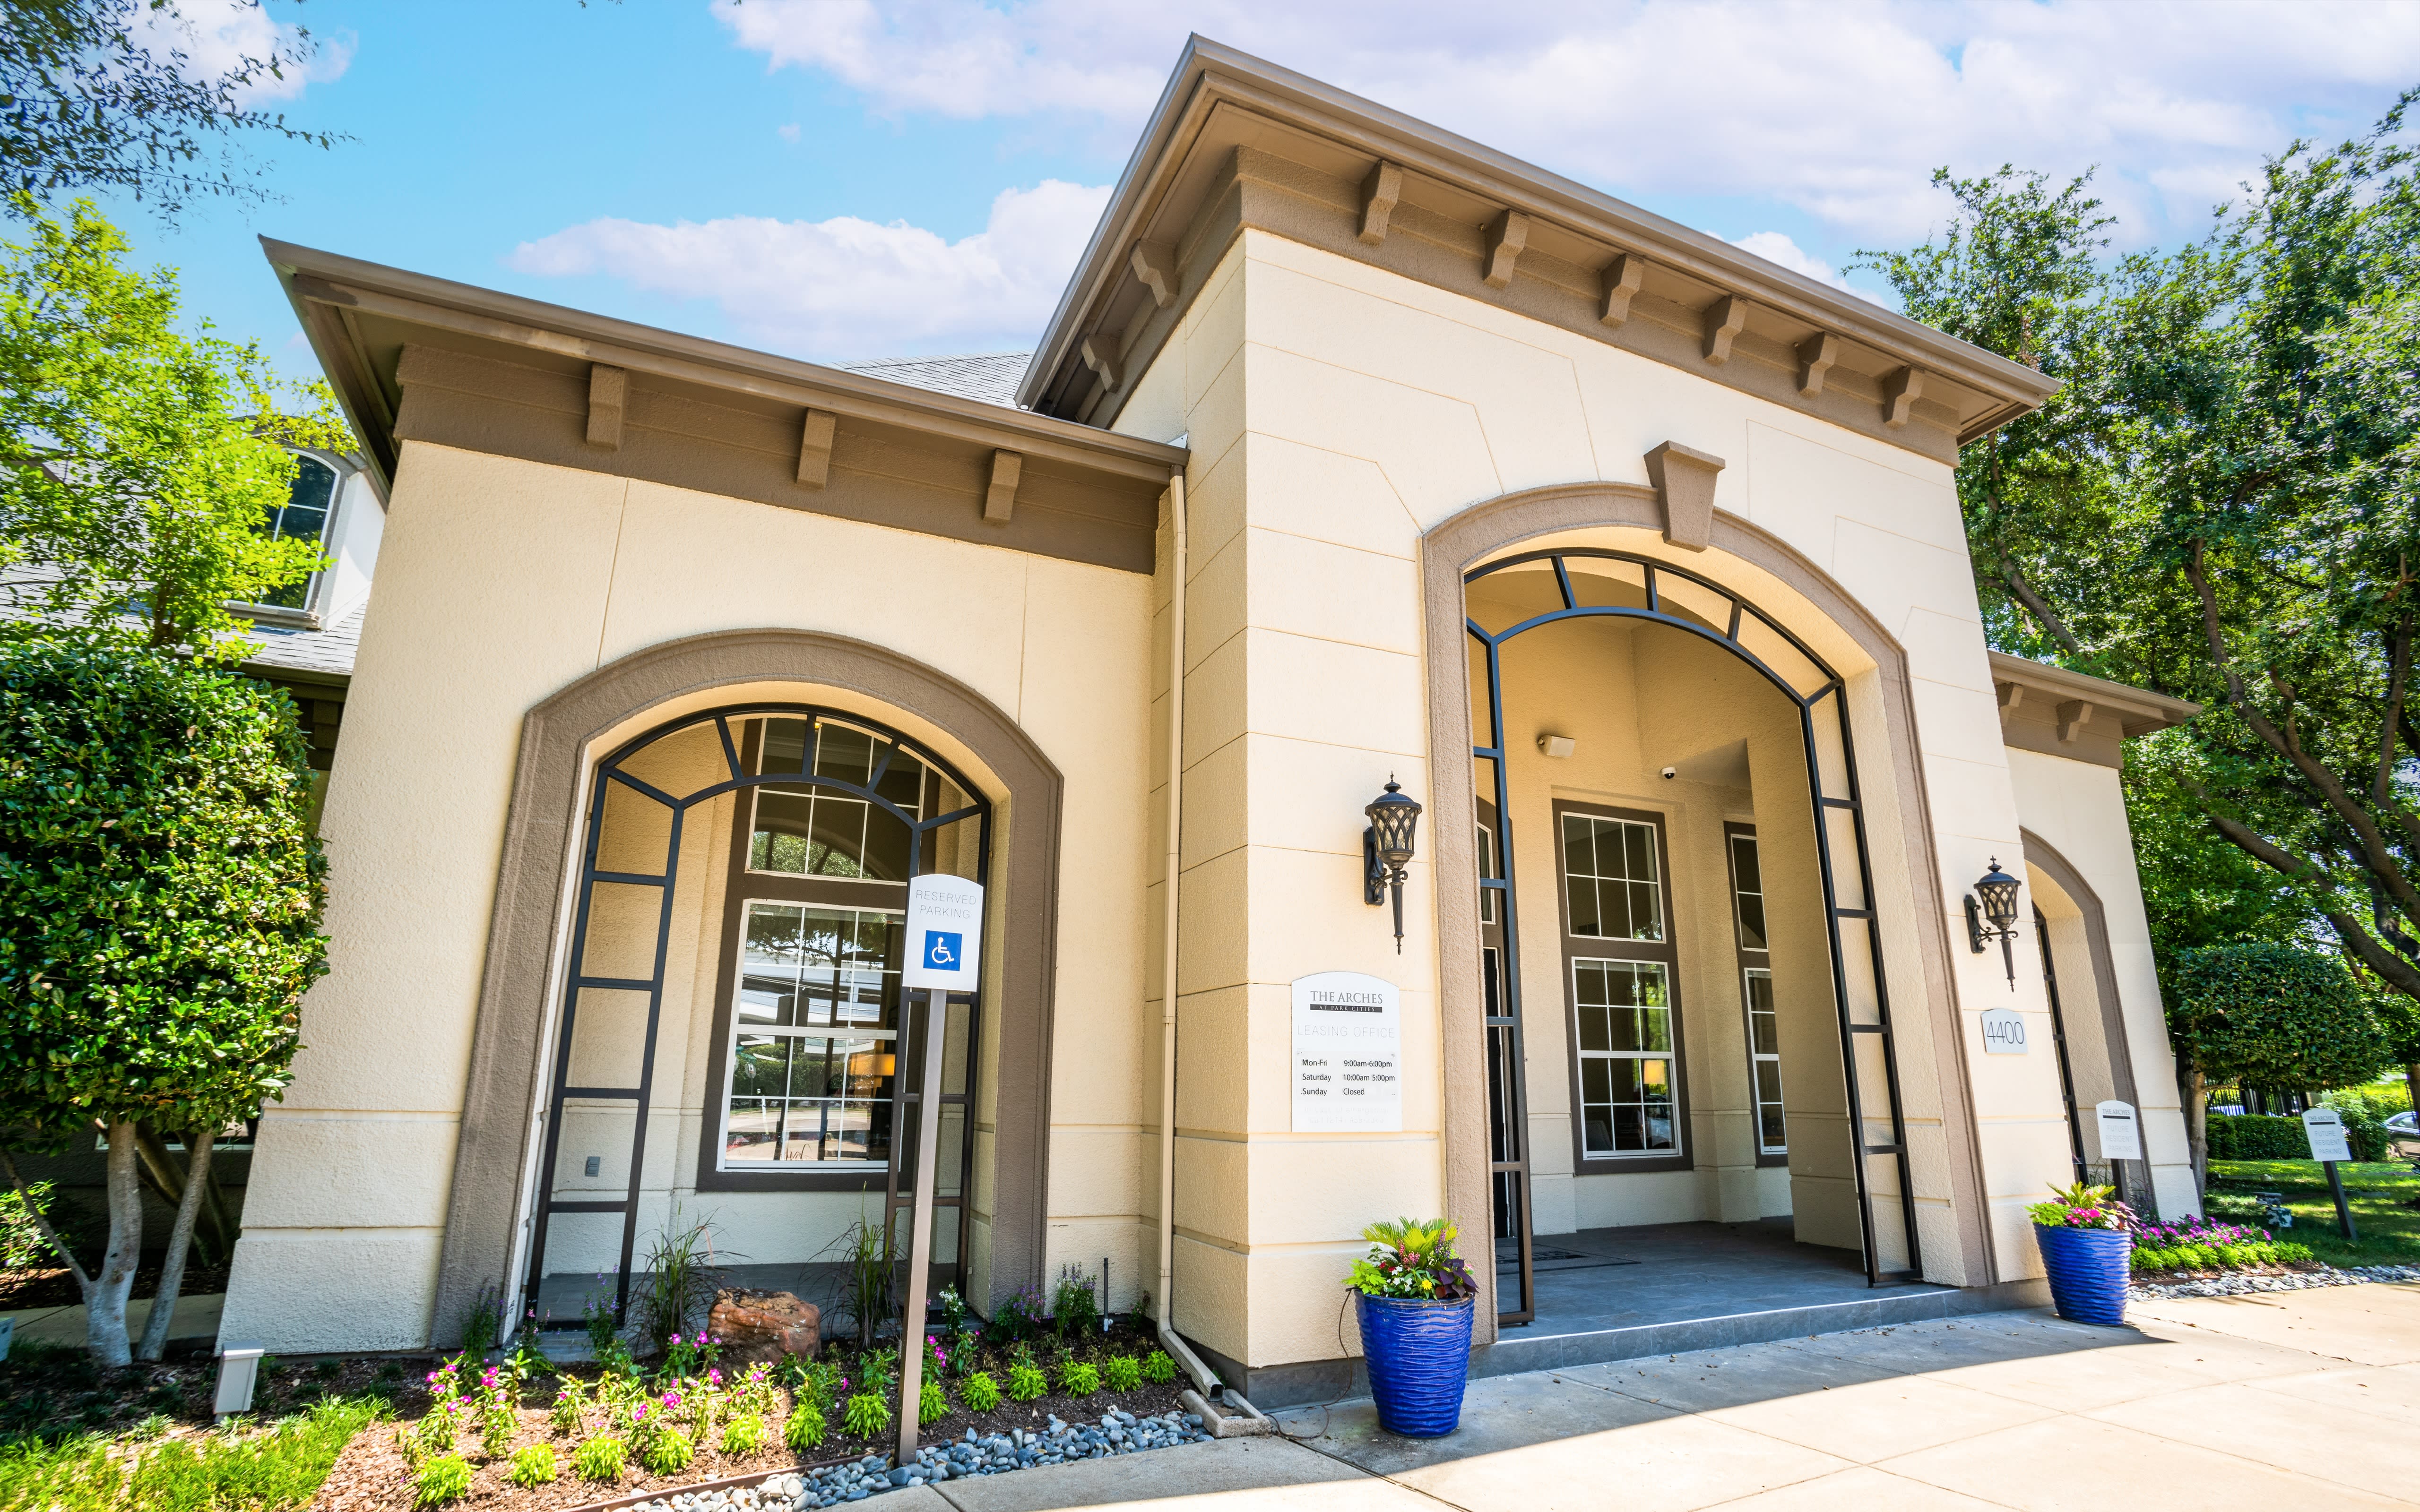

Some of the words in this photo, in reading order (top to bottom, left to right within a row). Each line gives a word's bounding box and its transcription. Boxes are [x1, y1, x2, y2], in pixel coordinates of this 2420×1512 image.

[916, 890, 976, 905] RESERVED
[920, 905, 970, 919] PARKING
[1310, 991, 1335, 1002] THE
[1337, 992, 1383, 1004] ARCHES
[1297, 1024, 1348, 1037] LEASING
[1353, 1027, 1395, 1038] OFFICE
[1987, 1021, 2024, 1044] 4400
[1344, 1060, 1392, 1068] 9:00am-6:00pm
[1302, 1073, 1331, 1082] Saturday
[1372, 1074, 1395, 1082] 5:00pm
[1303, 1088, 1327, 1096] Sunday
